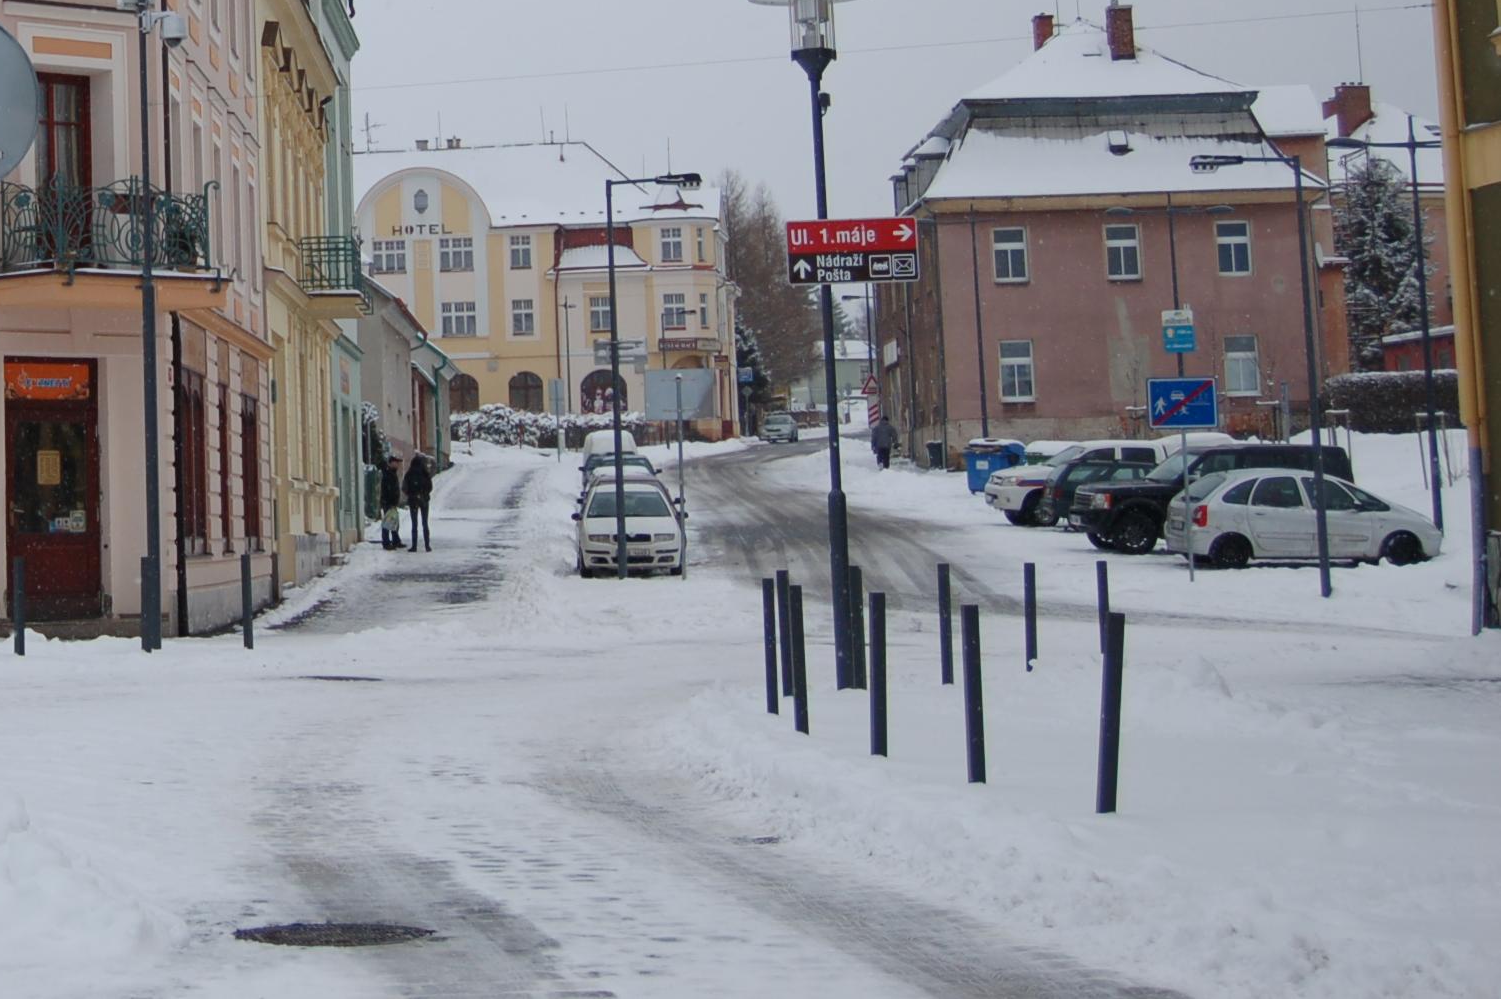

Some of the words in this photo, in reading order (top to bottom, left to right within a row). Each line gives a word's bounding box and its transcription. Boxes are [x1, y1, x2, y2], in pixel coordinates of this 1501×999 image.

[392, 223, 453, 236] HOTEL
[790, 228, 814, 246] Ul.
[819, 224, 876, 247] 1.máje
[816, 253, 864, 268] Nádraží
[817, 268, 852, 282] Pošta
